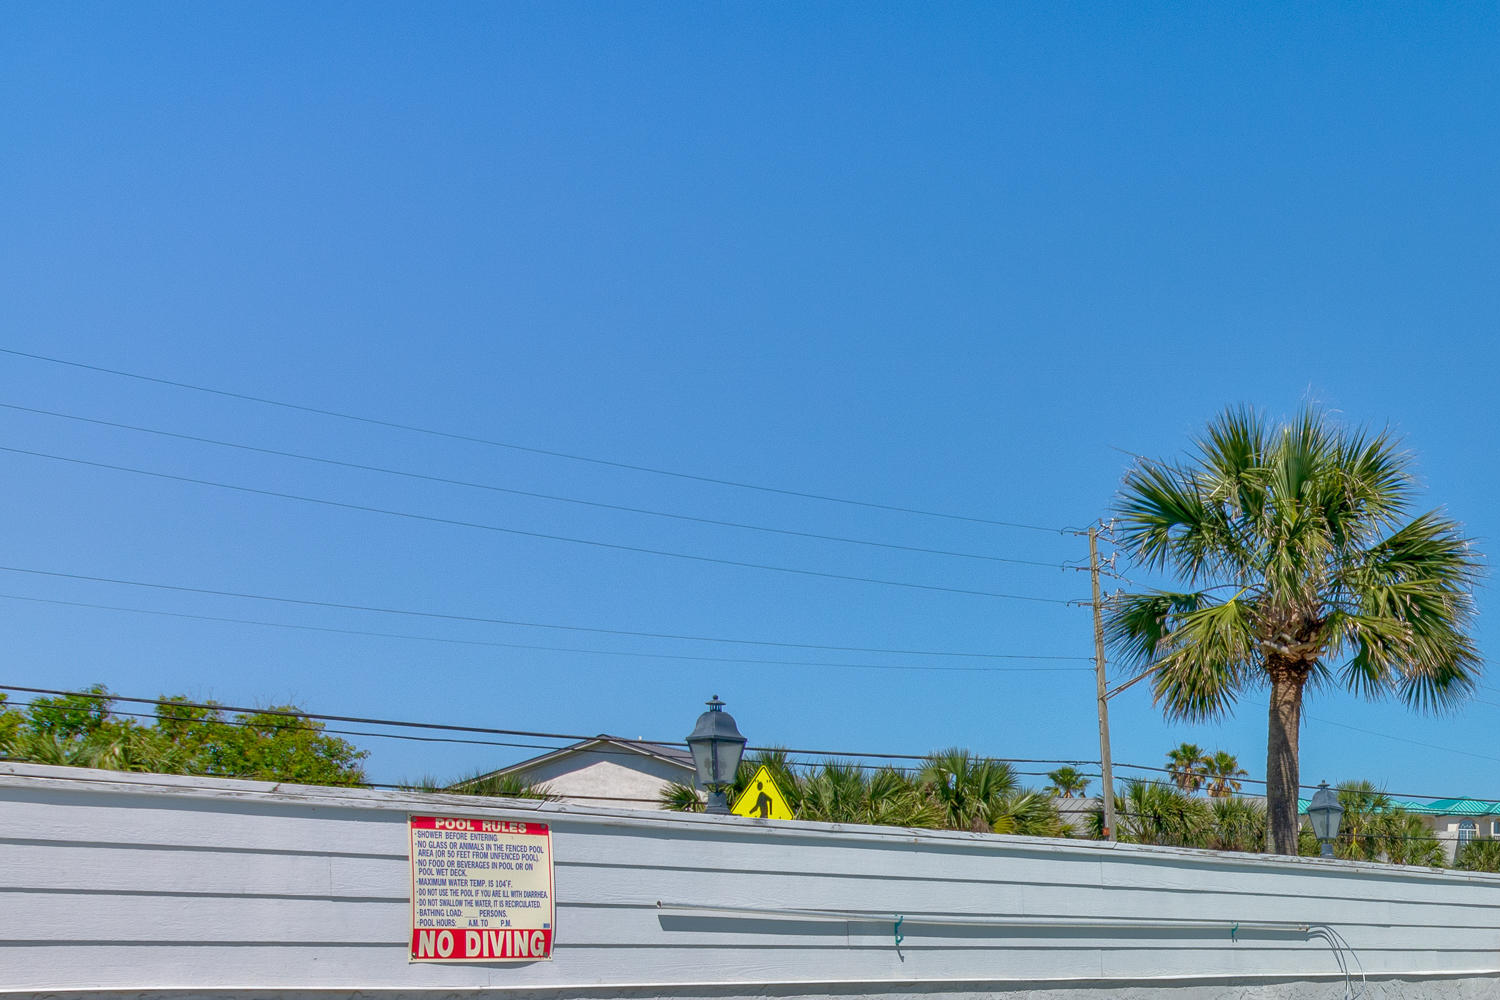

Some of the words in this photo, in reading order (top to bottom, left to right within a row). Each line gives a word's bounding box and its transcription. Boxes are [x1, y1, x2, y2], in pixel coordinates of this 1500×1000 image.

[436, 819, 474, 830] POOL
[482, 820, 526, 832] RULES
[459, 843, 484, 851] ANIMALS
[490, 852, 520, 860] UNFENCED
[418, 930, 454, 958] NO
[466, 930, 545, 958] DIVING
